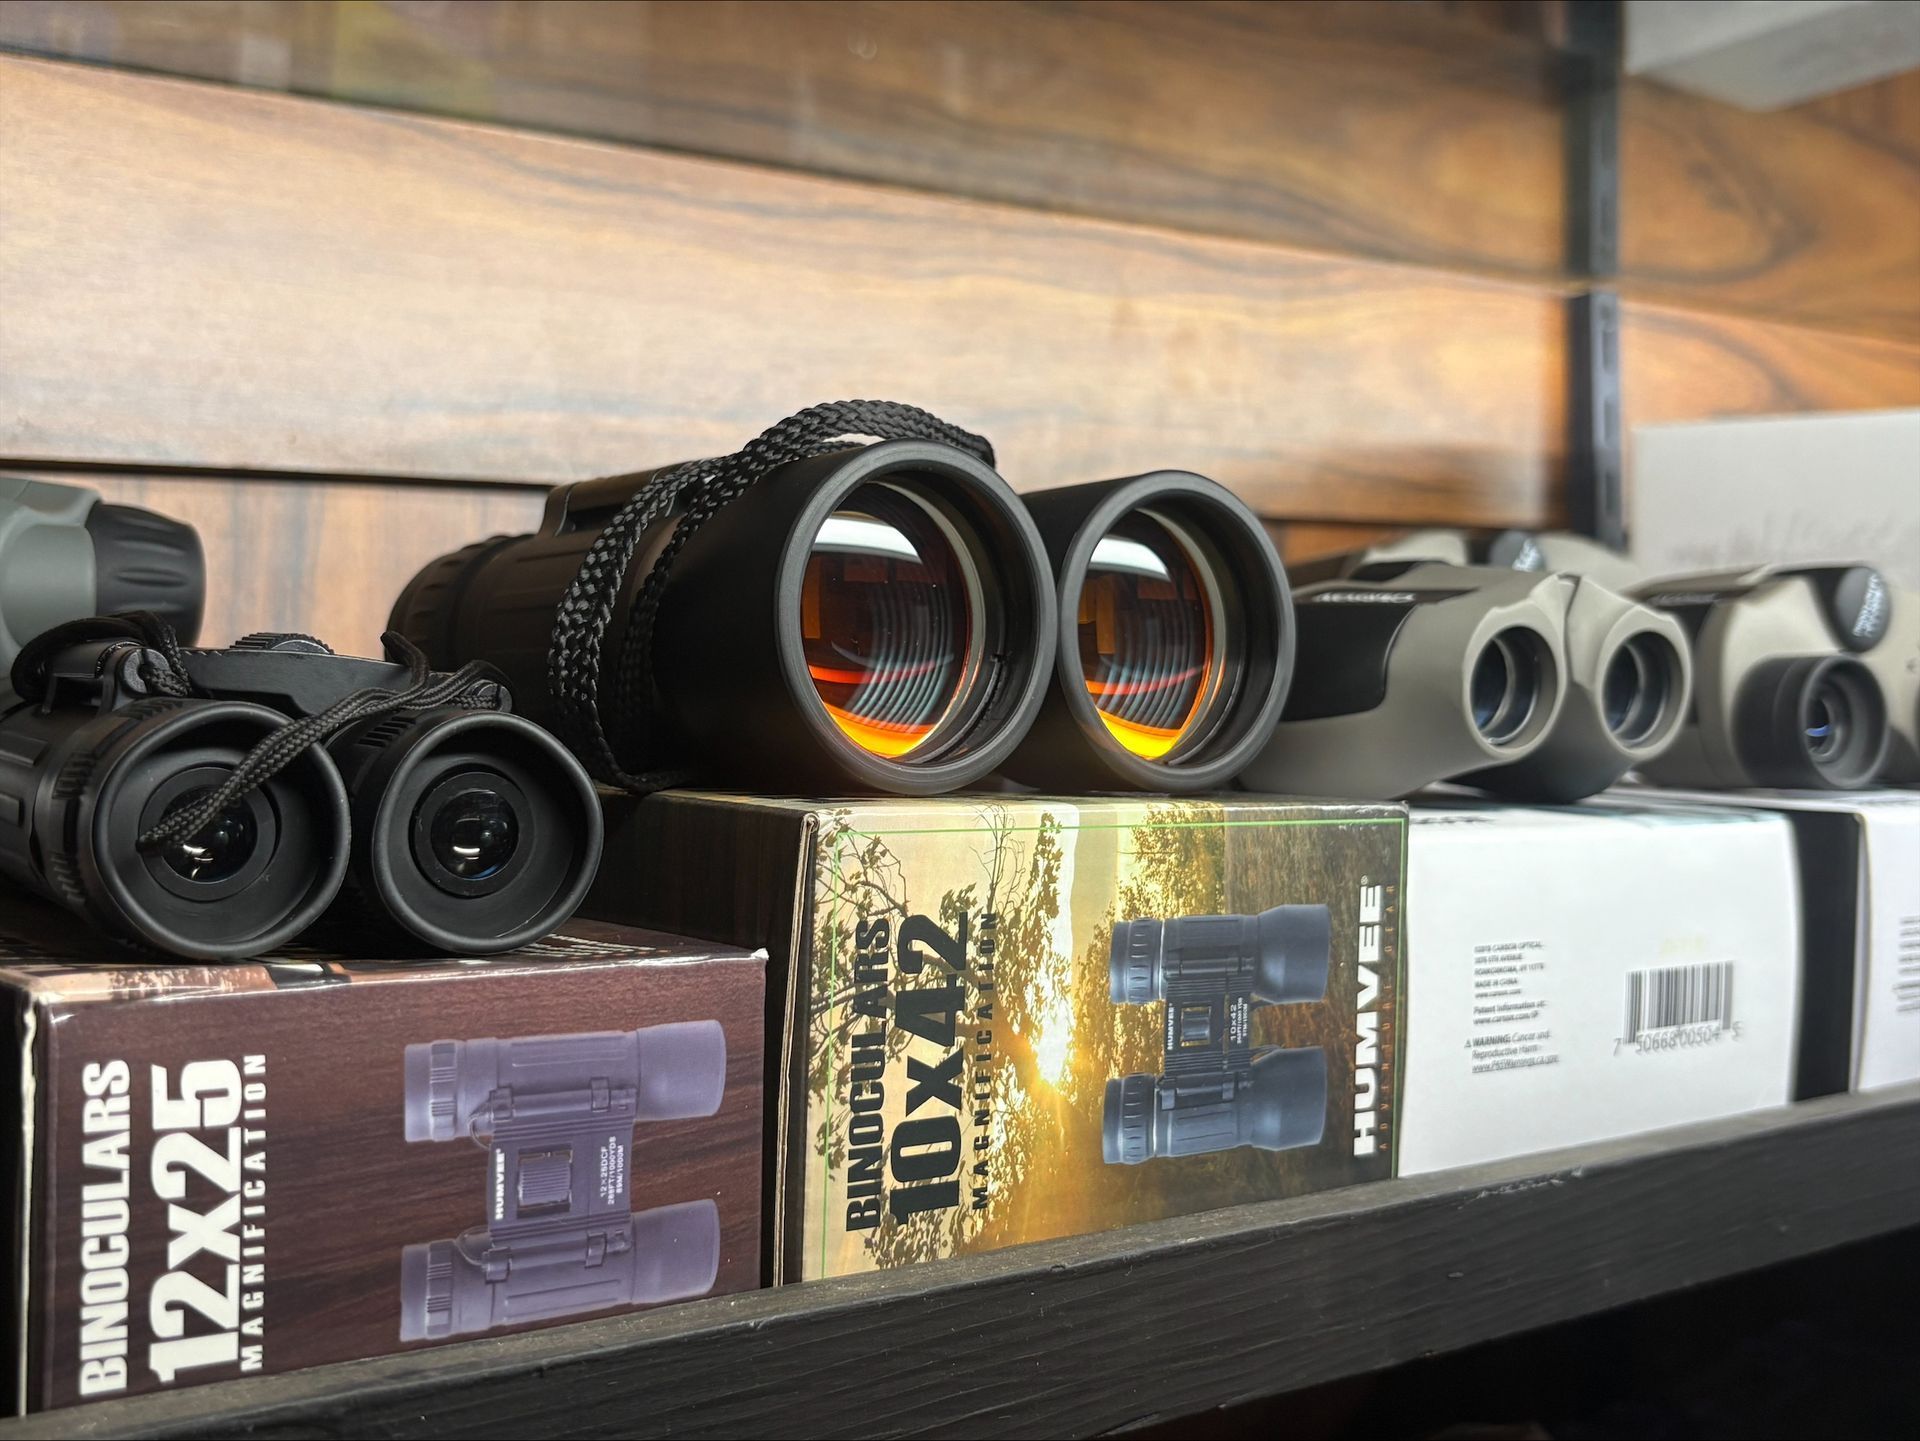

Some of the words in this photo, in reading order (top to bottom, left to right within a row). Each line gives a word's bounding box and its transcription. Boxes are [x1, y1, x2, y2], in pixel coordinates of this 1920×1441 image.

[240, 1055, 267, 1373] MAGNIFICATION
[846, 918, 890, 1231] BINOCULARS
[890, 912, 968, 1224] 10x42
[972, 913, 996, 1210] MAGNIFICATION
[80, 1060, 131, 1396] BINOCULARS
